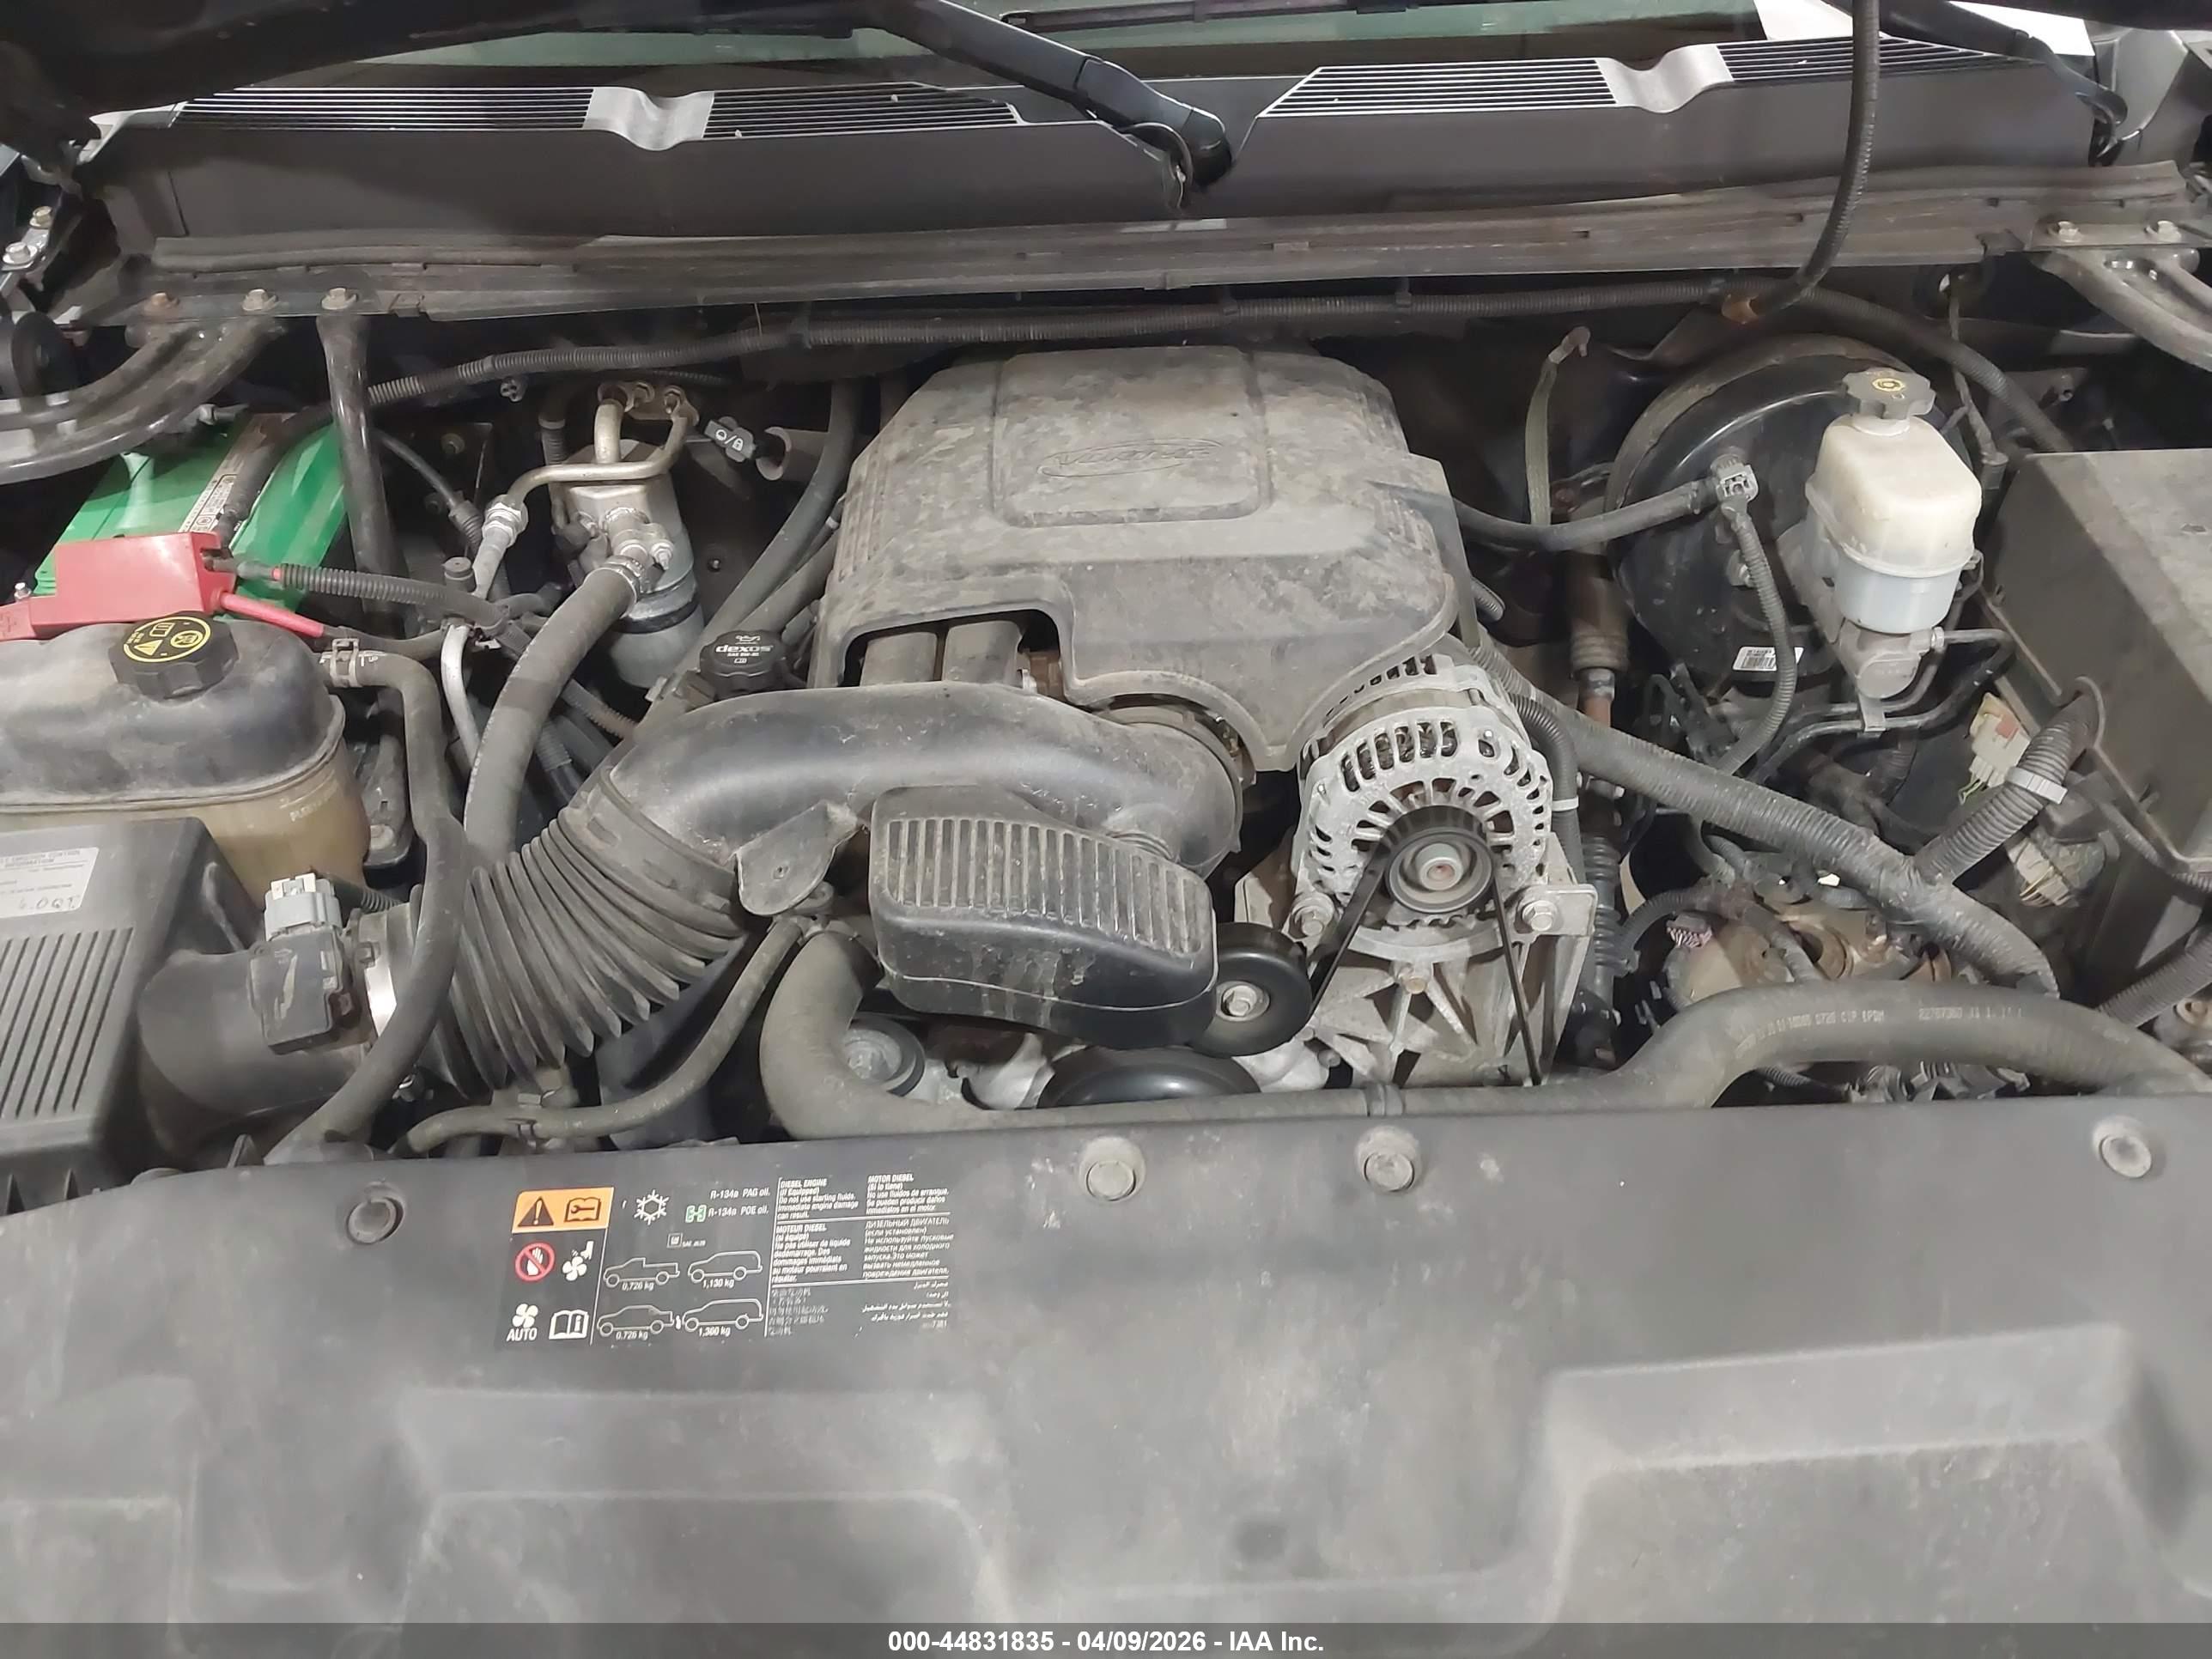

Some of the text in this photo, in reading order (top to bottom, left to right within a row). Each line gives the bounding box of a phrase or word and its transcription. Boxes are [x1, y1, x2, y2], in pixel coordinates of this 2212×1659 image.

[781, 1178, 827, 1188] DIESEL ENGINE
[868, 1173, 914, 1183] MOTOR DIESEL
[743, 1188, 758, 1198] PAG
[833, 1200, 859, 1209] damage
[776, 1223, 827, 1233] MOTEUR DIESEL
[644, 1281, 654, 1291] kg
[725, 1279, 734, 1288] kg
[506, 1328, 538, 1341] AUTO
[638, 1331, 648, 1340] kg
[720, 1327, 731, 1336] kg
